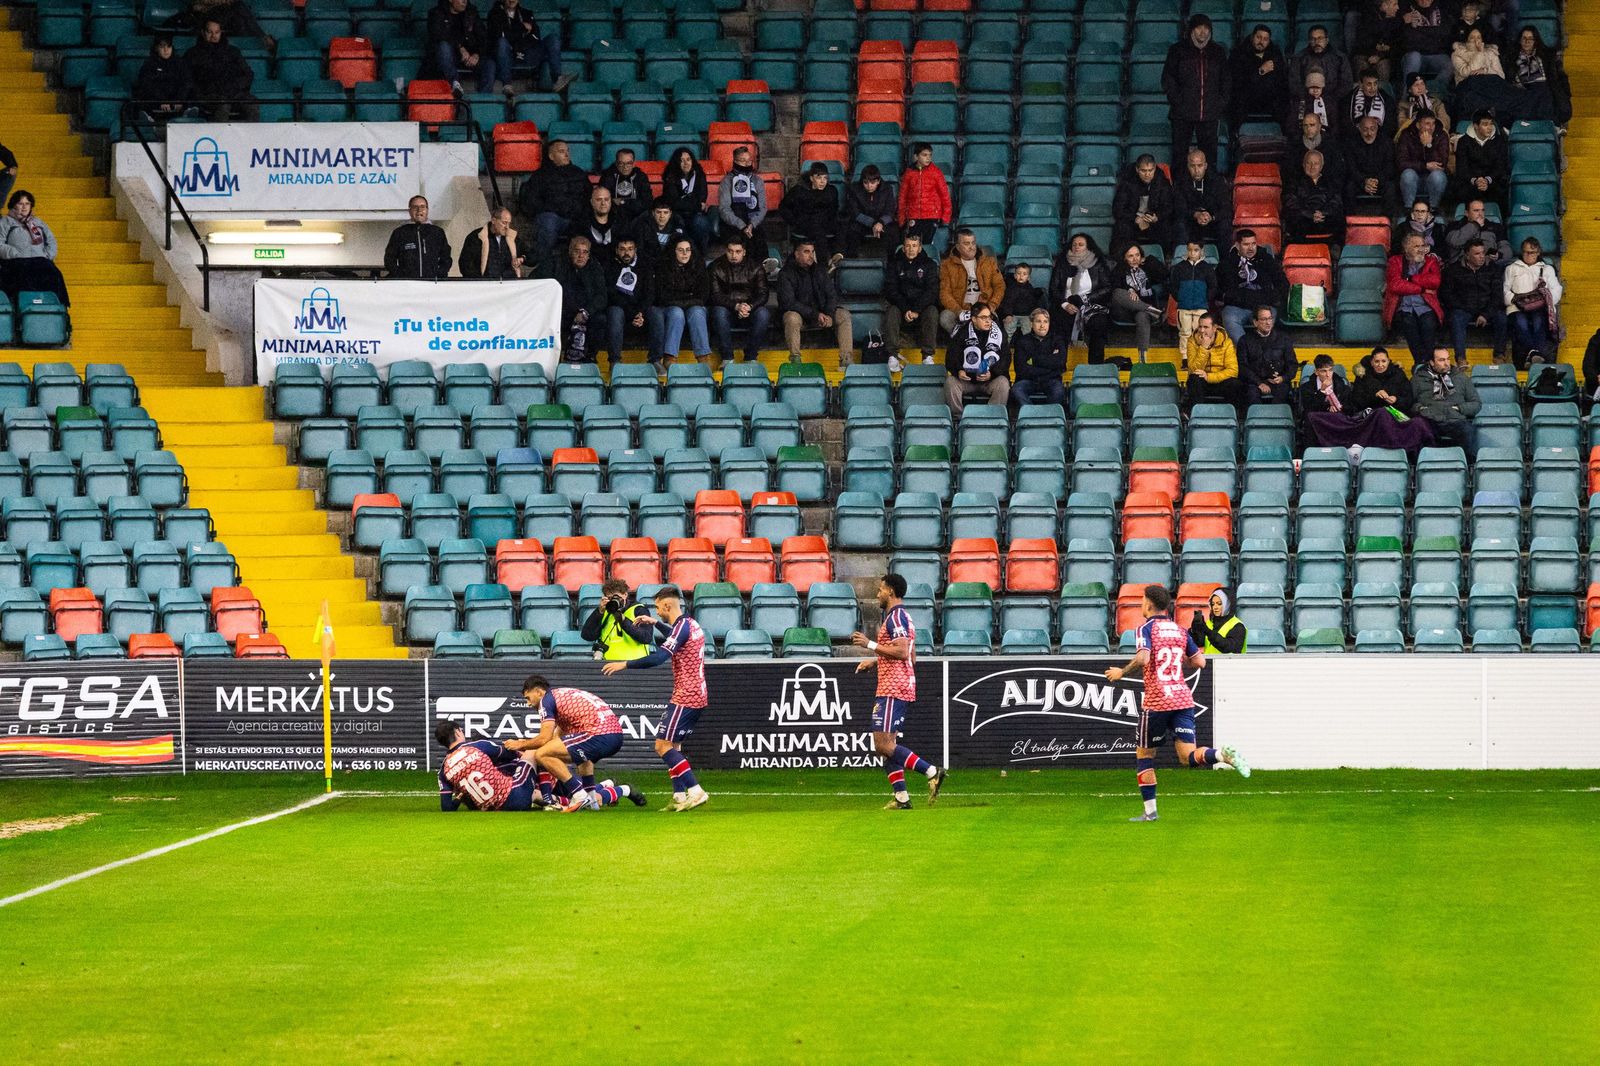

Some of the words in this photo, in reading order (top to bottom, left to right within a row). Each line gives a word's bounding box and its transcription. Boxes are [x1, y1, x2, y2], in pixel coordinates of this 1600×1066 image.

[250, 148, 414, 168] MINIMARKET
[268, 173, 333, 184] MIRANDA
[338, 173, 355, 184] DE
[360, 170, 397, 184] AZÁN
[255, 250, 284, 258] SALIDA
[394, 319, 422, 335] ¡Tu
[428, 317, 489, 332] tienda
[262, 339, 381, 354] MINIMARKET
[429, 337, 452, 351] de
[458, 335, 554, 351] confianza!
[275, 357, 322, 365] MIRANDA
[325, 357, 338, 365] DE
[216, 685, 394, 713] MERKATUS
[1001, 679, 1144, 717] ALJOMA
[226, 720, 279, 734] Agencia
[282, 720, 324, 732] creativ
[333, 722, 341, 734] y
[343, 720, 383, 734] digital
[204, 745, 227, 754] ESTÁS
[263, 747, 284, 755] ESTO,
[295, 747, 311, 755] QUE
[720, 732, 903, 753] MINIMARK
[1011, 739, 1031, 755] El
[1031, 738, 1069, 760] trabajo
[1072, 739, 1086, 750] de
[1106, 737, 1138, 752] fami
[351, 761, 371, 770] 636
[373, 761, 385, 770] 10
[388, 761, 402, 770] 89
[404, 761, 418, 770] 75
[740, 757, 813, 768] MIRANDA
[818, 757, 838, 768] DE
[842, 754, 884, 768] AZÁN
[460, 771, 494, 804] 16
